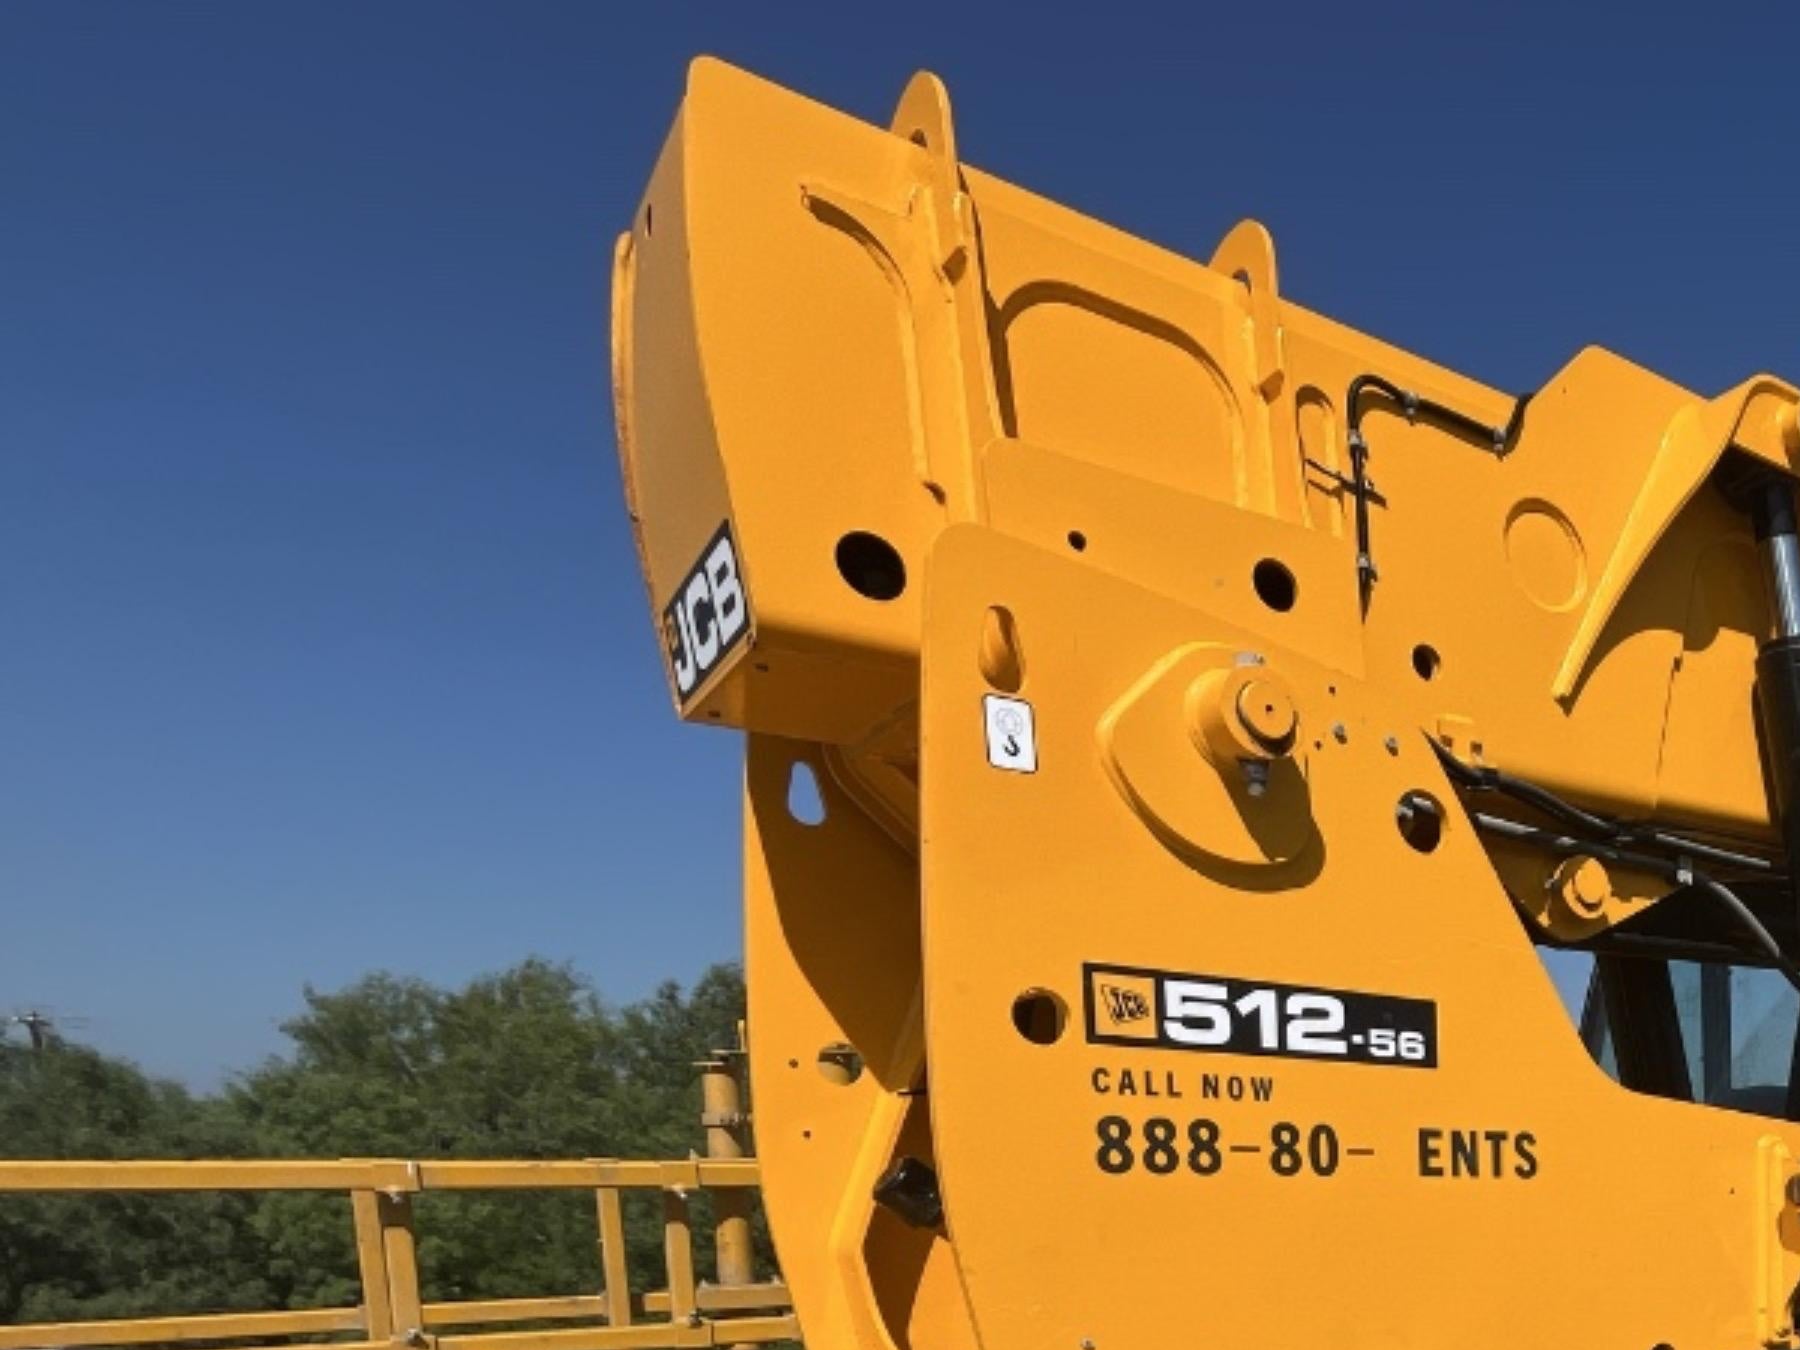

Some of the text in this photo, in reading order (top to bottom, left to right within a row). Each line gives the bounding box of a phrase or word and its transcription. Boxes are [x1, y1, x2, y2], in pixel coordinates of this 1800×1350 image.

[674, 536, 746, 694] JCB
[1092, 1067, 1274, 1101] CALL NOW
[1418, 1127, 1538, 1179] ENTS
